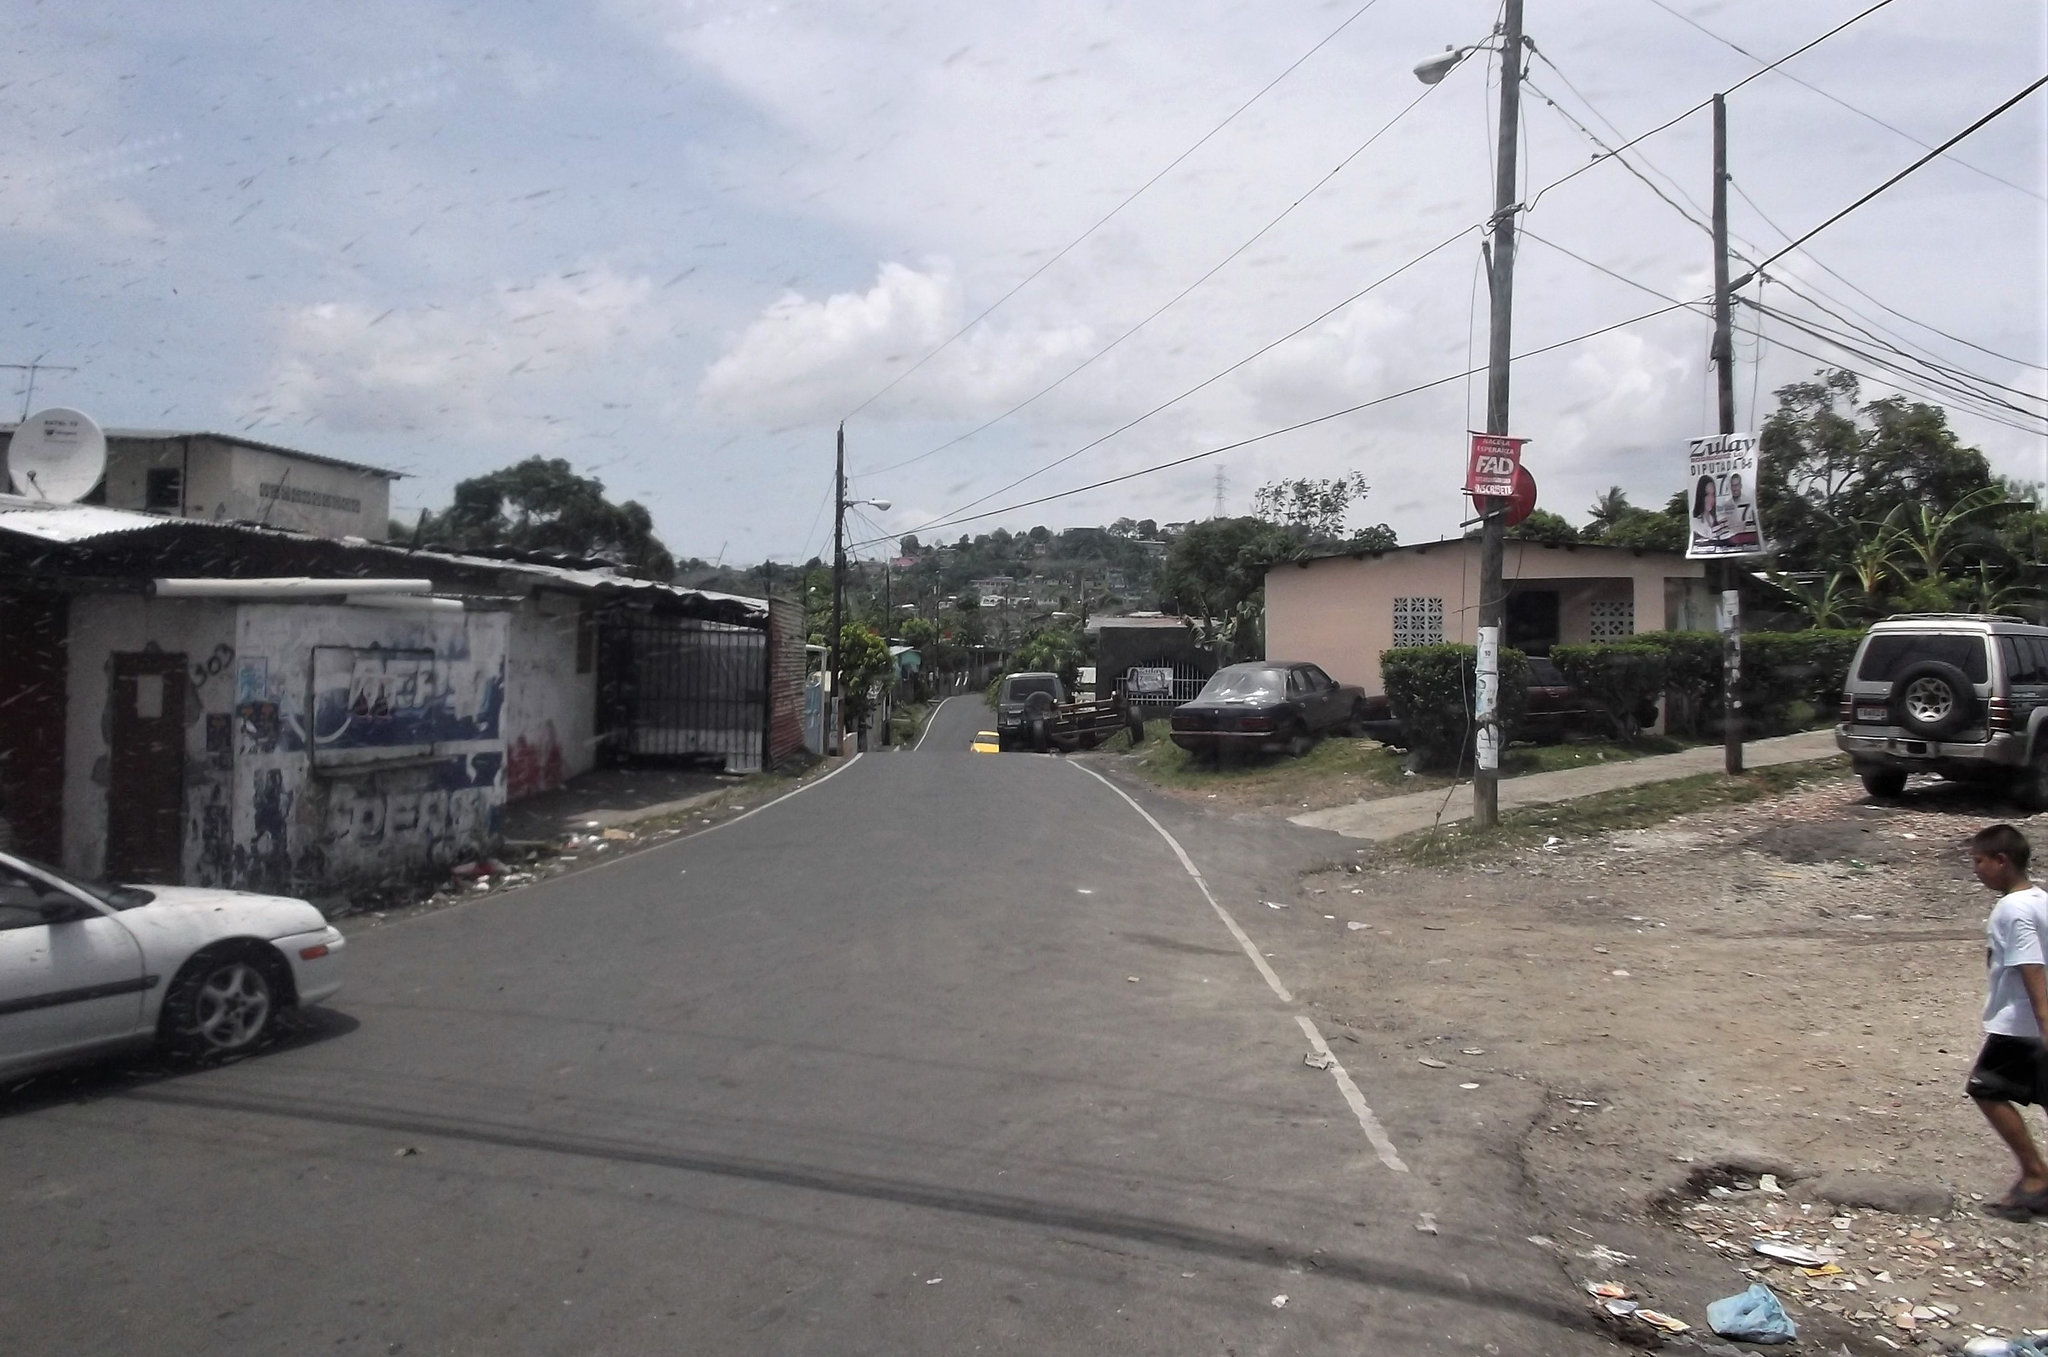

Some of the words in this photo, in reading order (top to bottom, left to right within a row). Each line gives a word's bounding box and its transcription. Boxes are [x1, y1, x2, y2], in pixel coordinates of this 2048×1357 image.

[1690, 435, 1756, 459] Zulay
[1475, 455, 1514, 475] FAD
[1690, 459, 1738, 476] DIPUTADA
